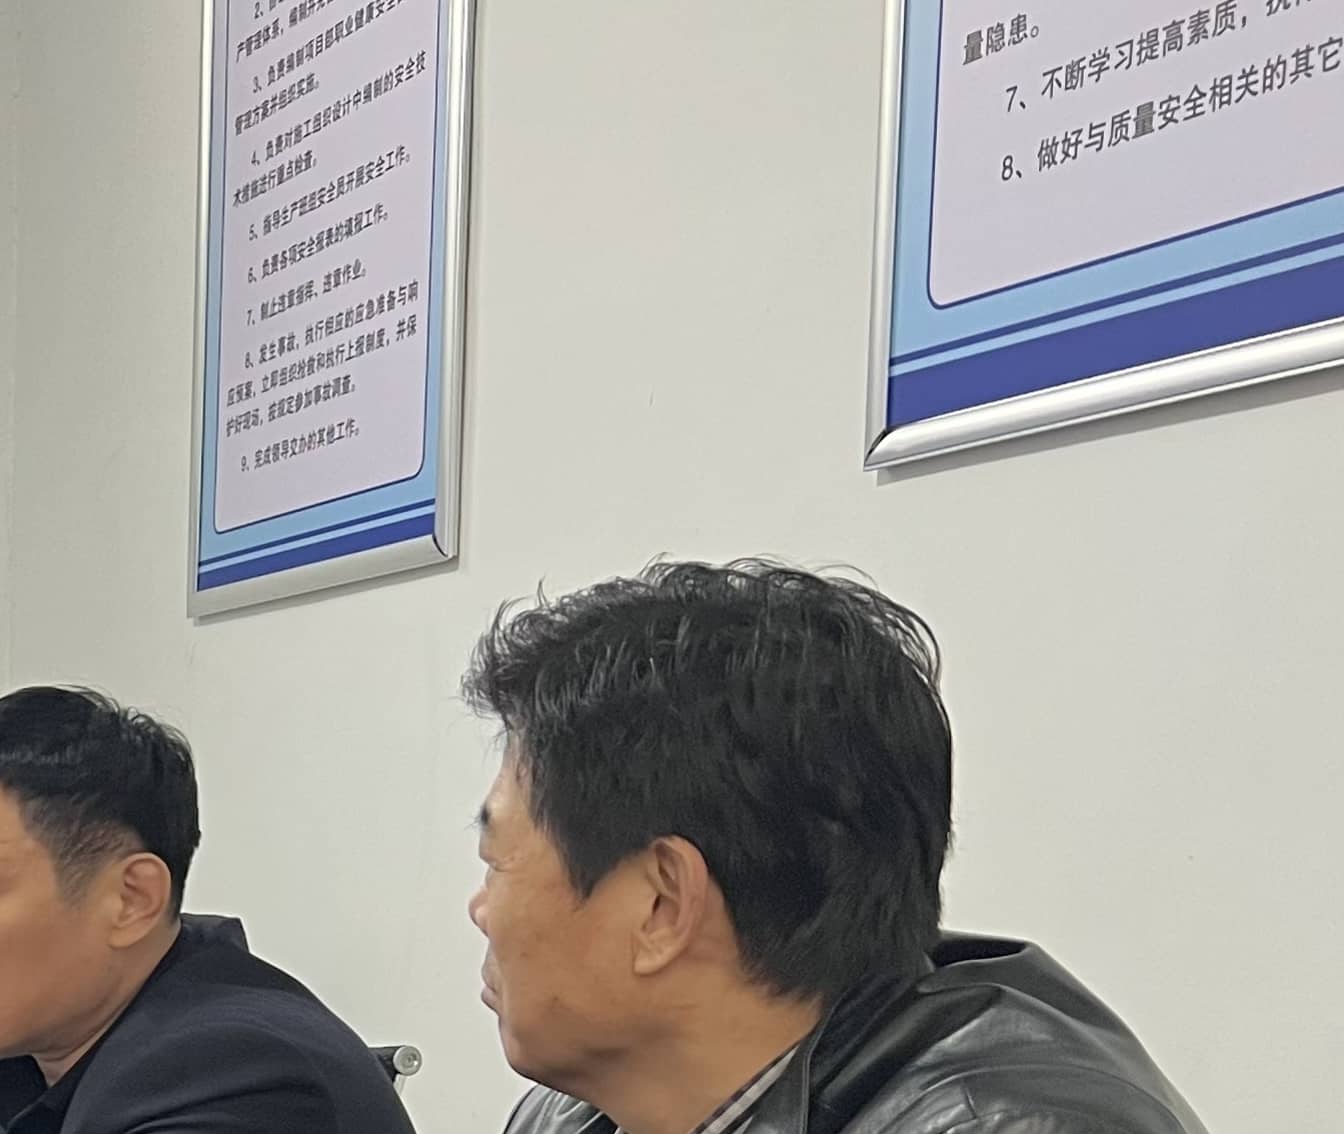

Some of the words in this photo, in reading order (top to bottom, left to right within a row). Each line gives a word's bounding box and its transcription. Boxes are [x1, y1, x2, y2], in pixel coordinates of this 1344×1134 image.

[962, 13, 1040, 66] 量隐患。
[1005, 0, 1315, 113] 7、不断学习提高素质，
[1000, 36, 1344, 181] 8、做好与质量安全相关的其它
